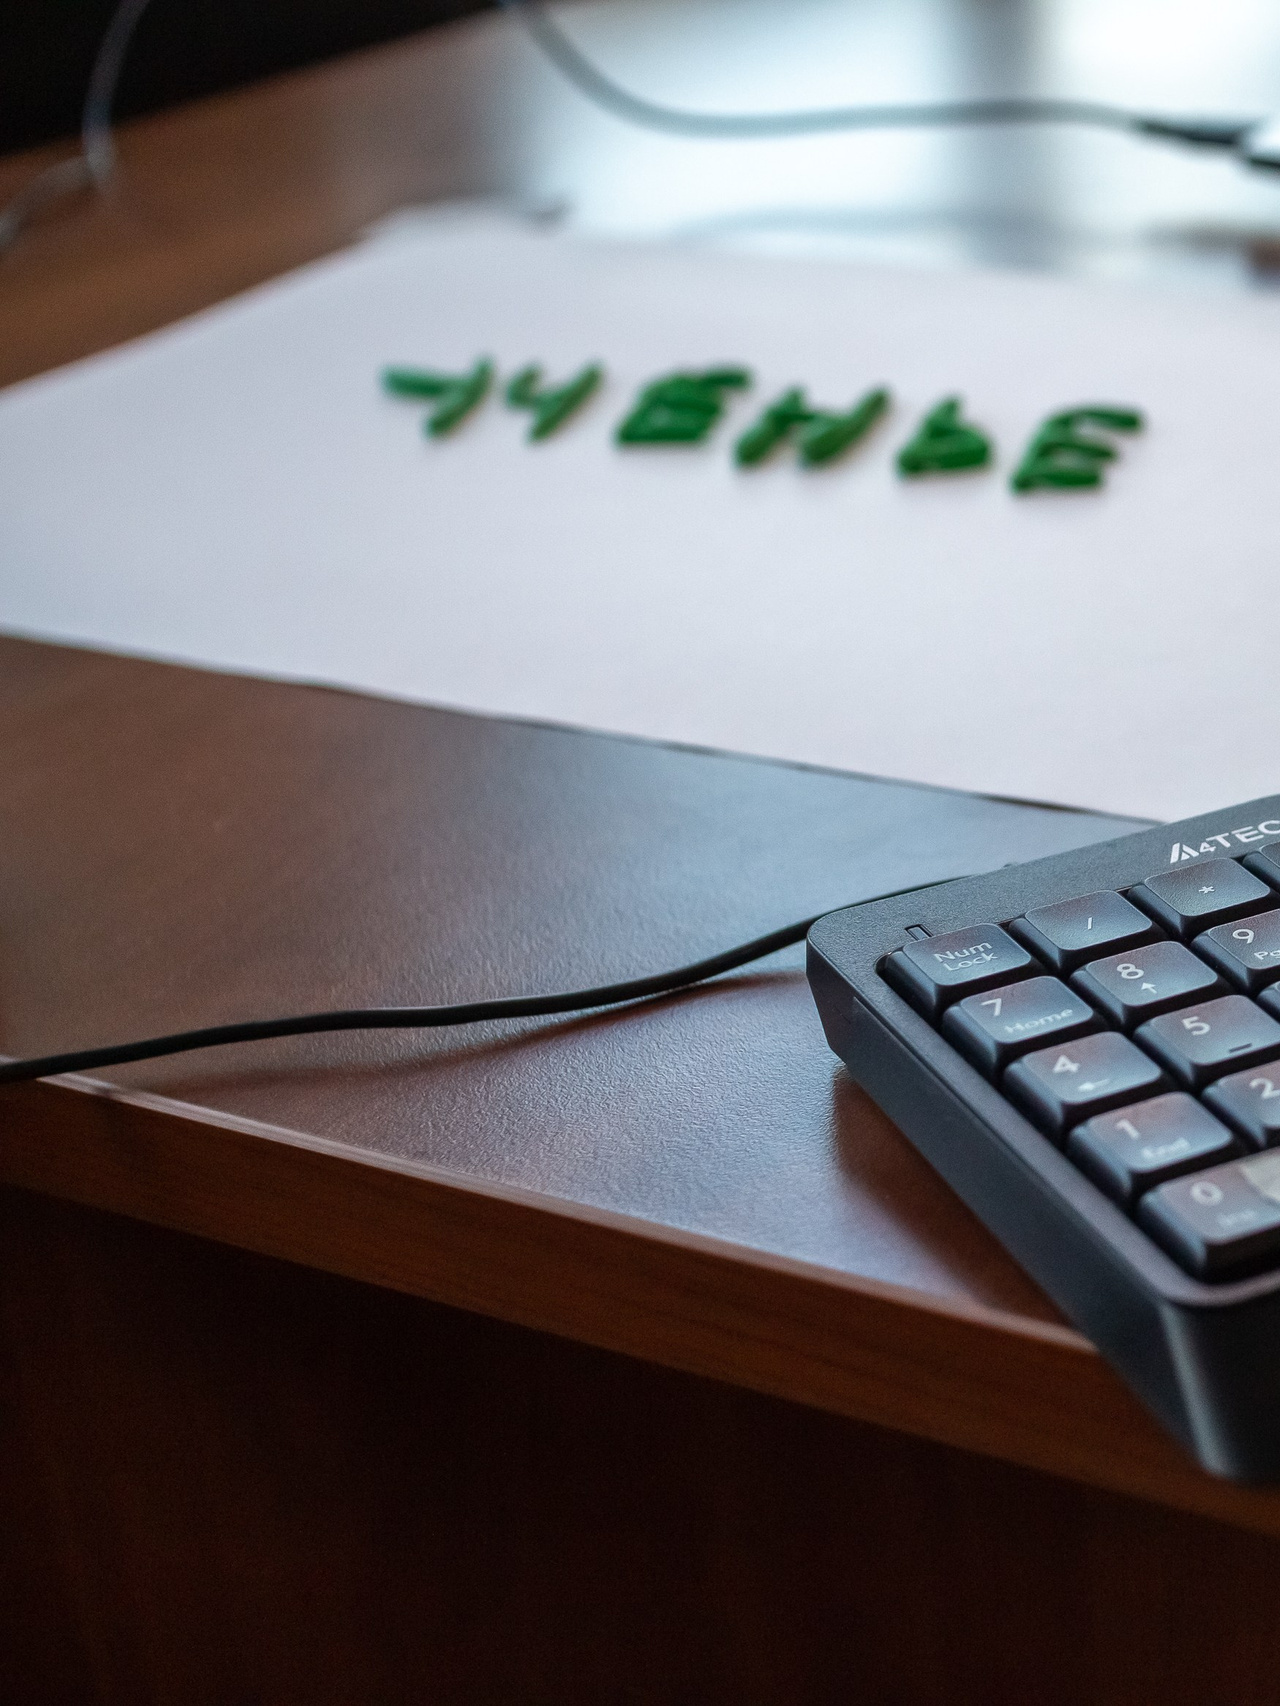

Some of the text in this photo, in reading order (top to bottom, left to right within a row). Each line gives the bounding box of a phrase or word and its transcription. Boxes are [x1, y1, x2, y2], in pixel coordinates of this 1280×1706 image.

[1232, 928, 1255, 944] 9
[933, 942, 992, 962] Num
[943, 951, 998, 971] Lock
[1116, 963, 1144, 979] 8
[981, 998, 1002, 1016] 7
[1004, 1008, 1073, 1033] Home
[1181, 1016, 1211, 1036] 5
[1052, 1054, 1080, 1074] 4
[1114, 1119, 1140, 1140] 1
[1190, 1181, 1223, 1206] 0
